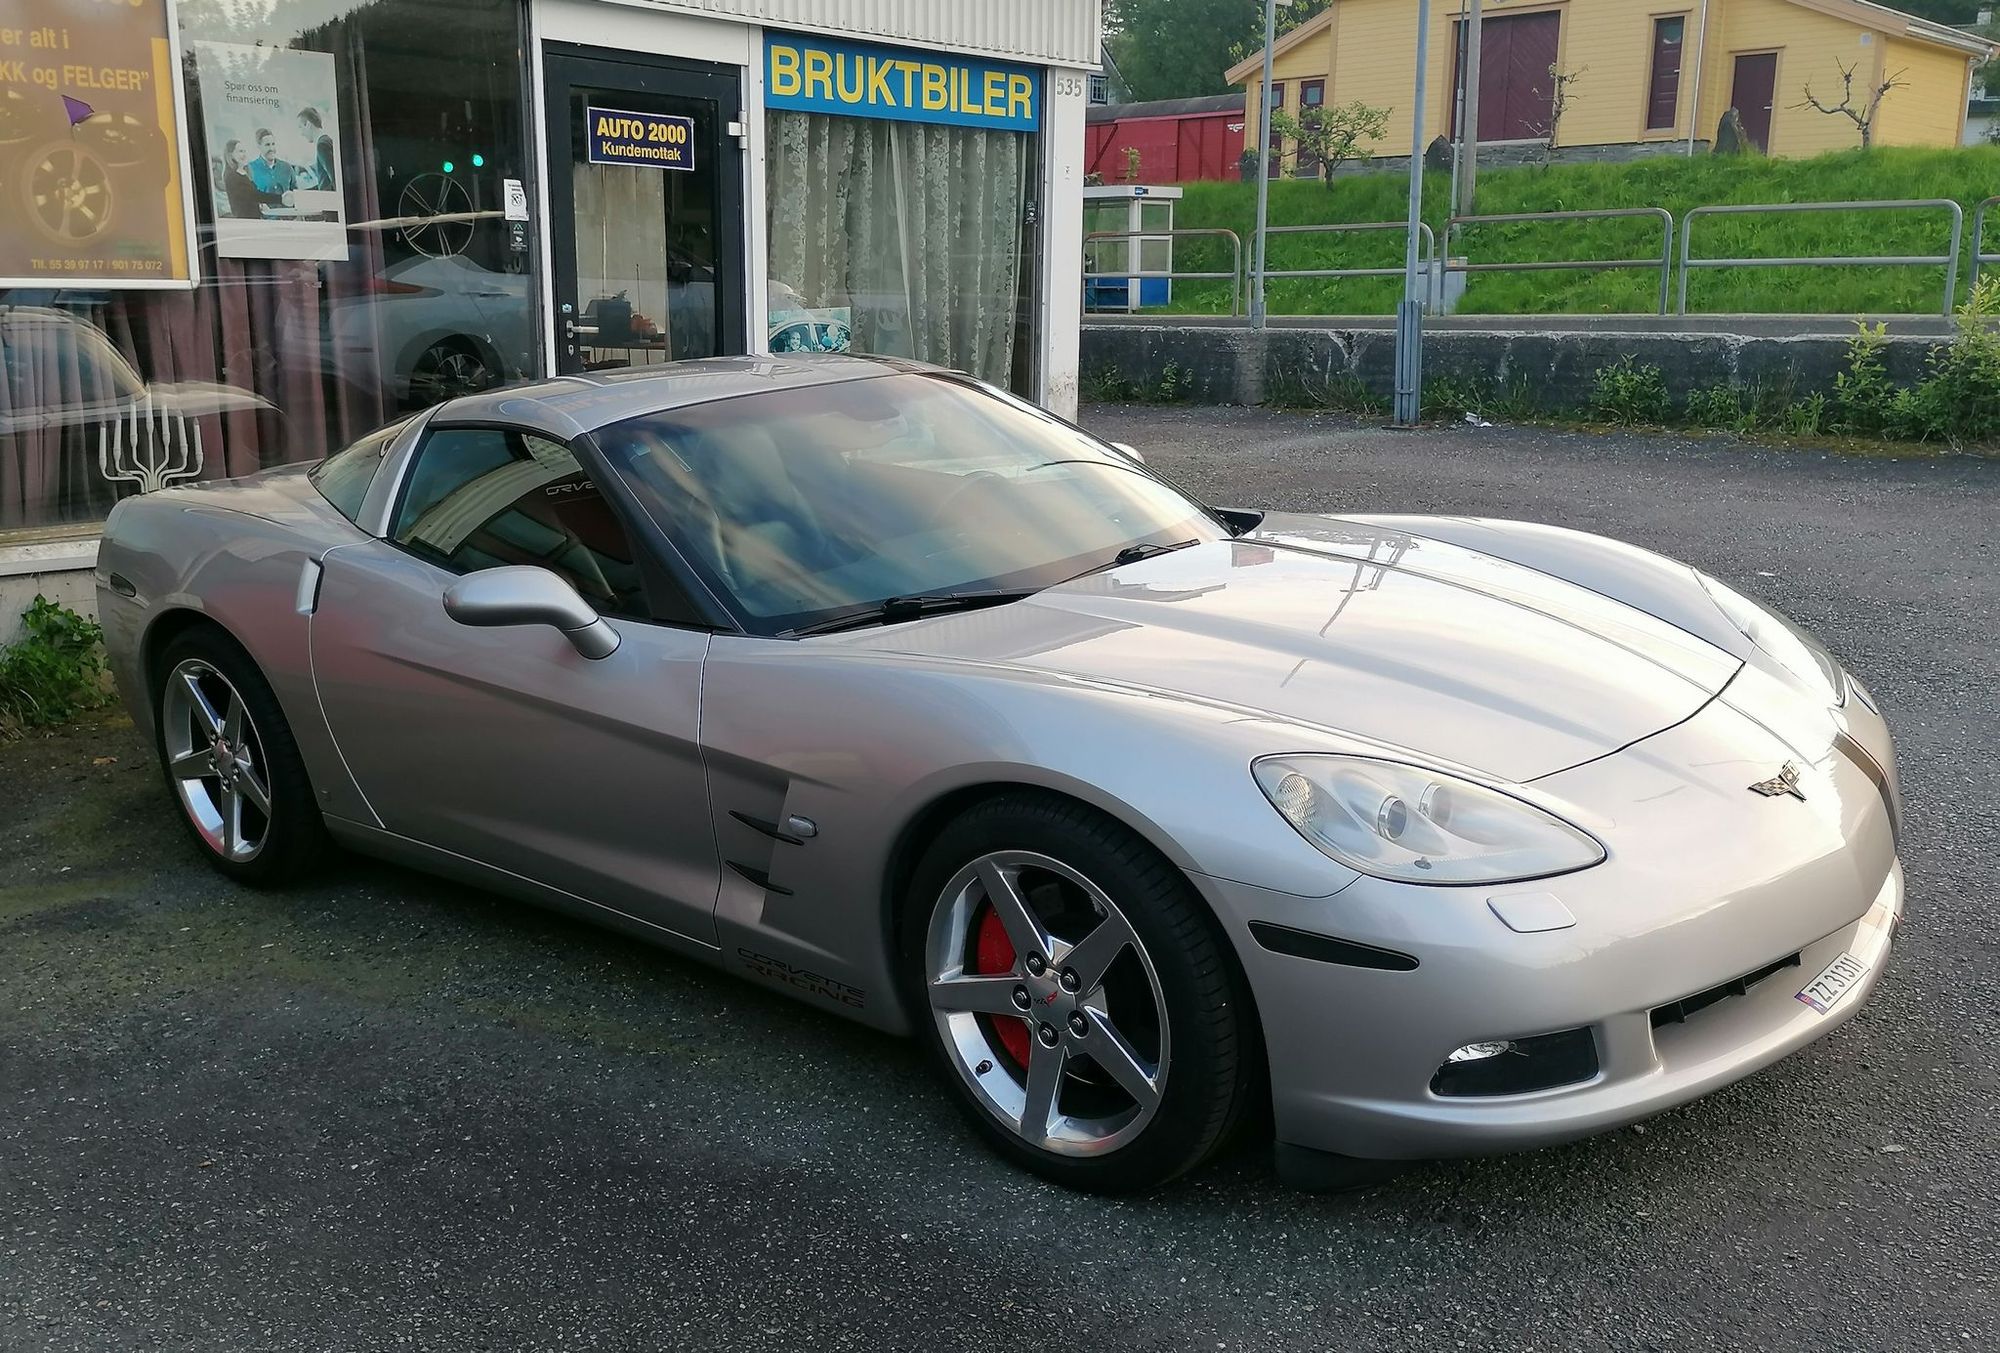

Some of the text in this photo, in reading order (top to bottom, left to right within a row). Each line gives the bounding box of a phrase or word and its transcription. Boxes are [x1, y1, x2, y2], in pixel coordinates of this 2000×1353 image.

[30, 27, 56, 48] alt
[62, 29, 69, 49] i
[0, 60, 27, 82] KK
[32, 67, 58, 90] og
[770, 44, 1033, 119] BRUKTBILER
[248, 84, 262, 93] oss
[264, 86, 279, 94] om
[1056, 77, 1082, 97] 535
[226, 93, 280, 109] finansiering
[596, 116, 687, 144] AUTO 2000
[602, 141, 682, 161] Kundemottak
[50, 259, 62, 270] 55
[64, 259, 77, 270] 39
[93, 260, 104, 270] 17
[111, 260, 129, 271] 901
[132, 260, 143, 270] 75
[145, 261, 163, 271] 072
[738, 947, 865, 999] CORVETTE
[745, 960, 864, 1009] RACING
[1808, 981, 1839, 1002] ZZ
